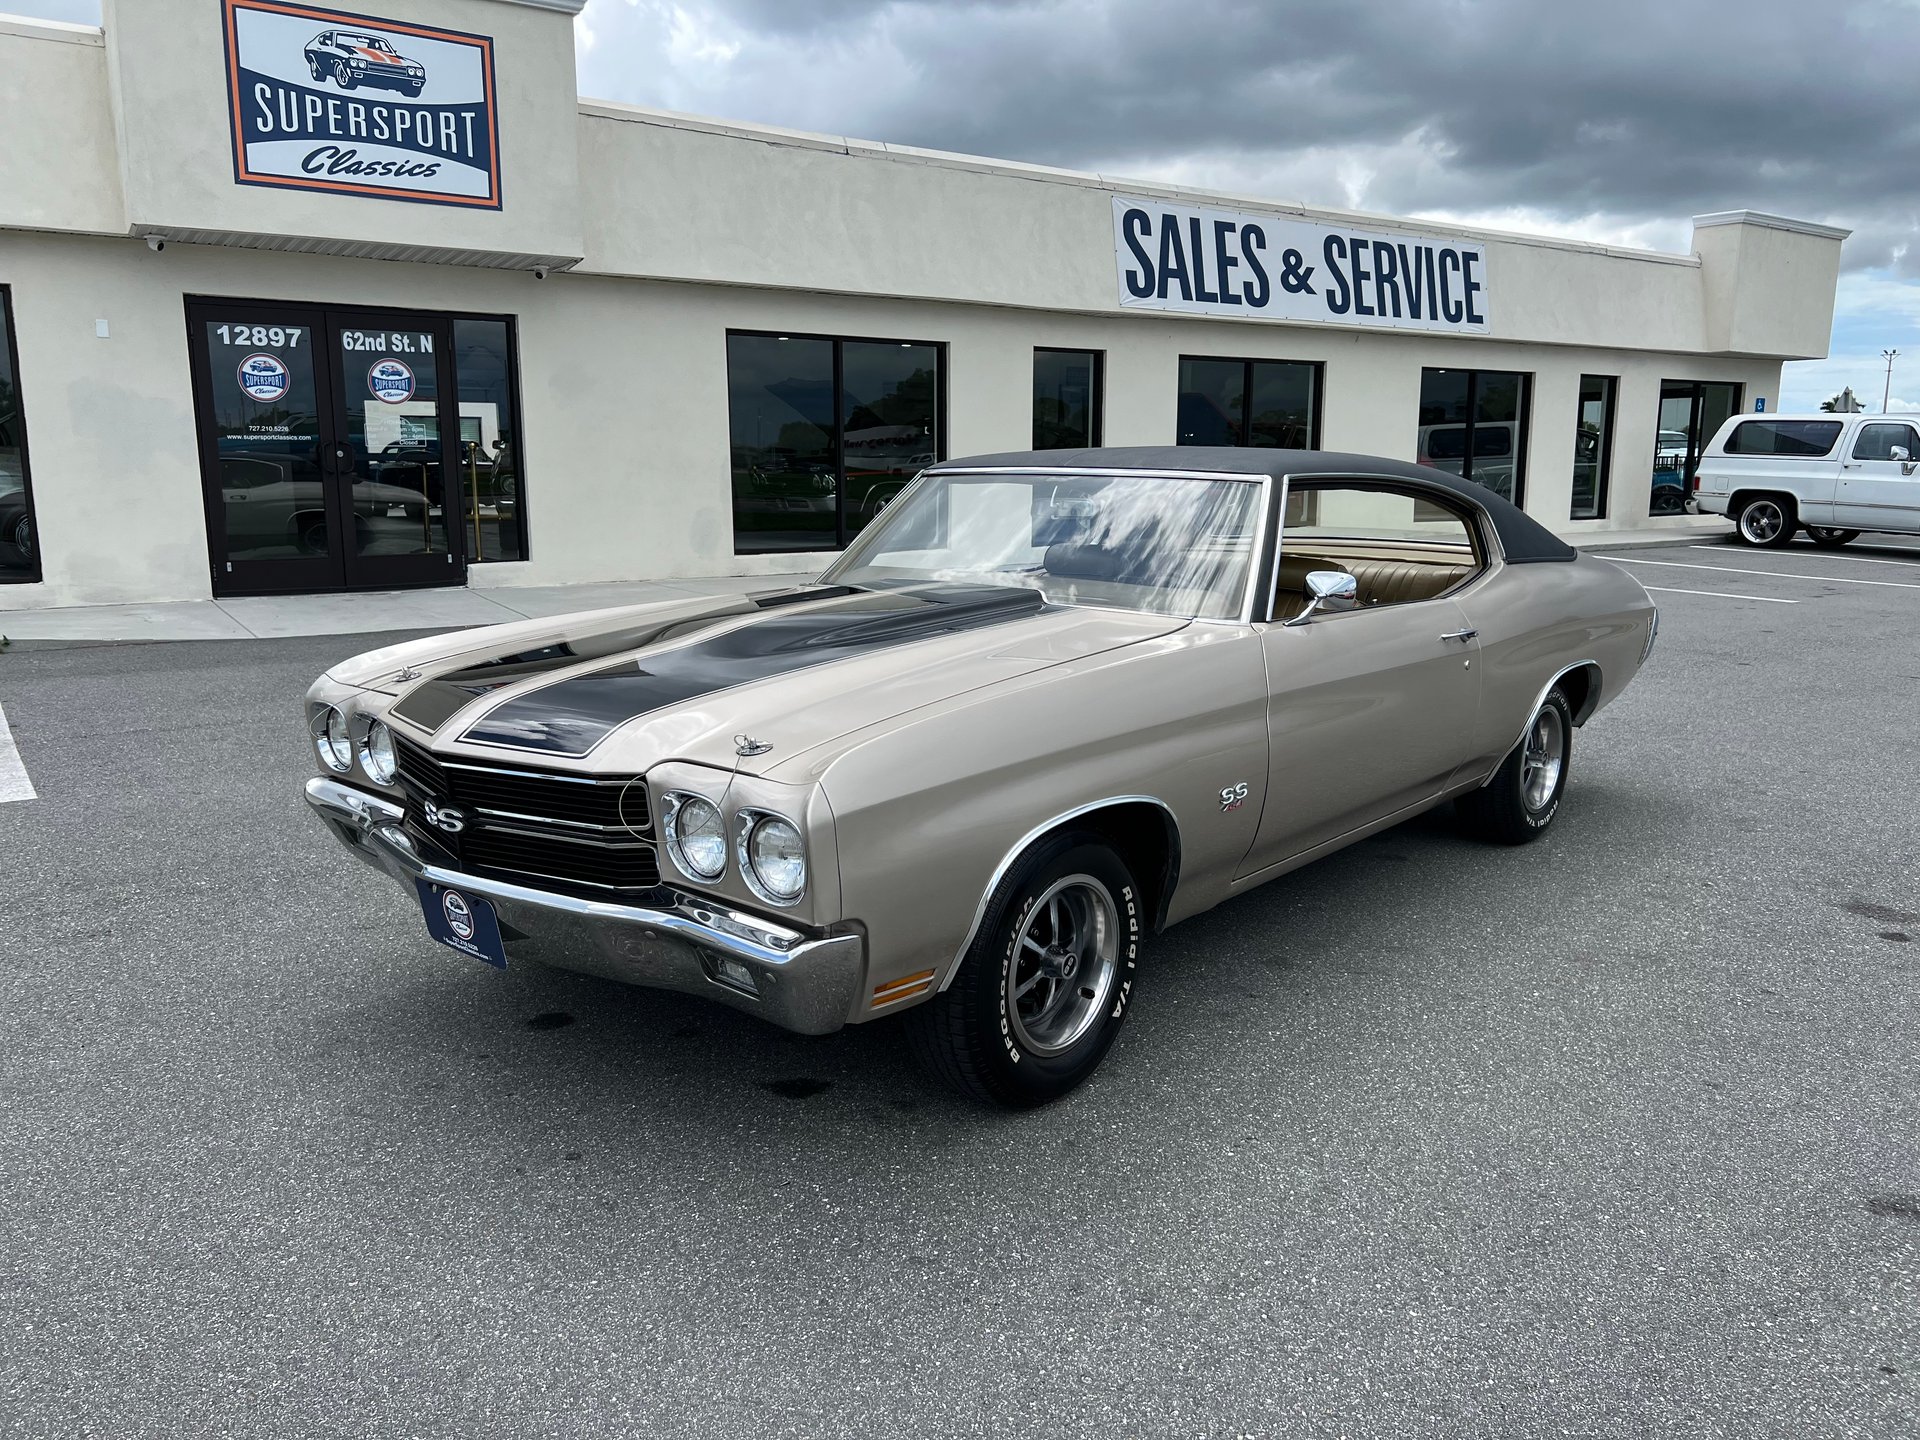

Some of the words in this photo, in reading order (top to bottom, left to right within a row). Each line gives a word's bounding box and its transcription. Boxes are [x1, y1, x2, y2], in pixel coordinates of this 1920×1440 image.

[254, 83, 476, 158] SUPERSPORT
[301, 145, 442, 177] Classics
[1122, 208, 1270, 308] SALES
[1280, 248, 1317, 295] &
[1323, 234, 1484, 325] SERVICE
[217, 325, 302, 348] 12897
[342, 331, 386, 351] 62nd
[391, 333, 415, 352] St.
[420, 335, 433, 353] N
[245, 374, 283, 387] SUPERSPORT
[375, 379, 409, 391] SUPERSPORT
[227, 433, 312, 441] www.supersportclassics.com
[1221, 782, 1248, 804] SS
[424, 800, 464, 833] SS
[1537, 800, 1559, 828] Radial
[1121, 885, 1139, 969] Radial
[999, 896, 1033, 1064] BFGoodrich
[1112, 980, 1131, 1018] T/A
